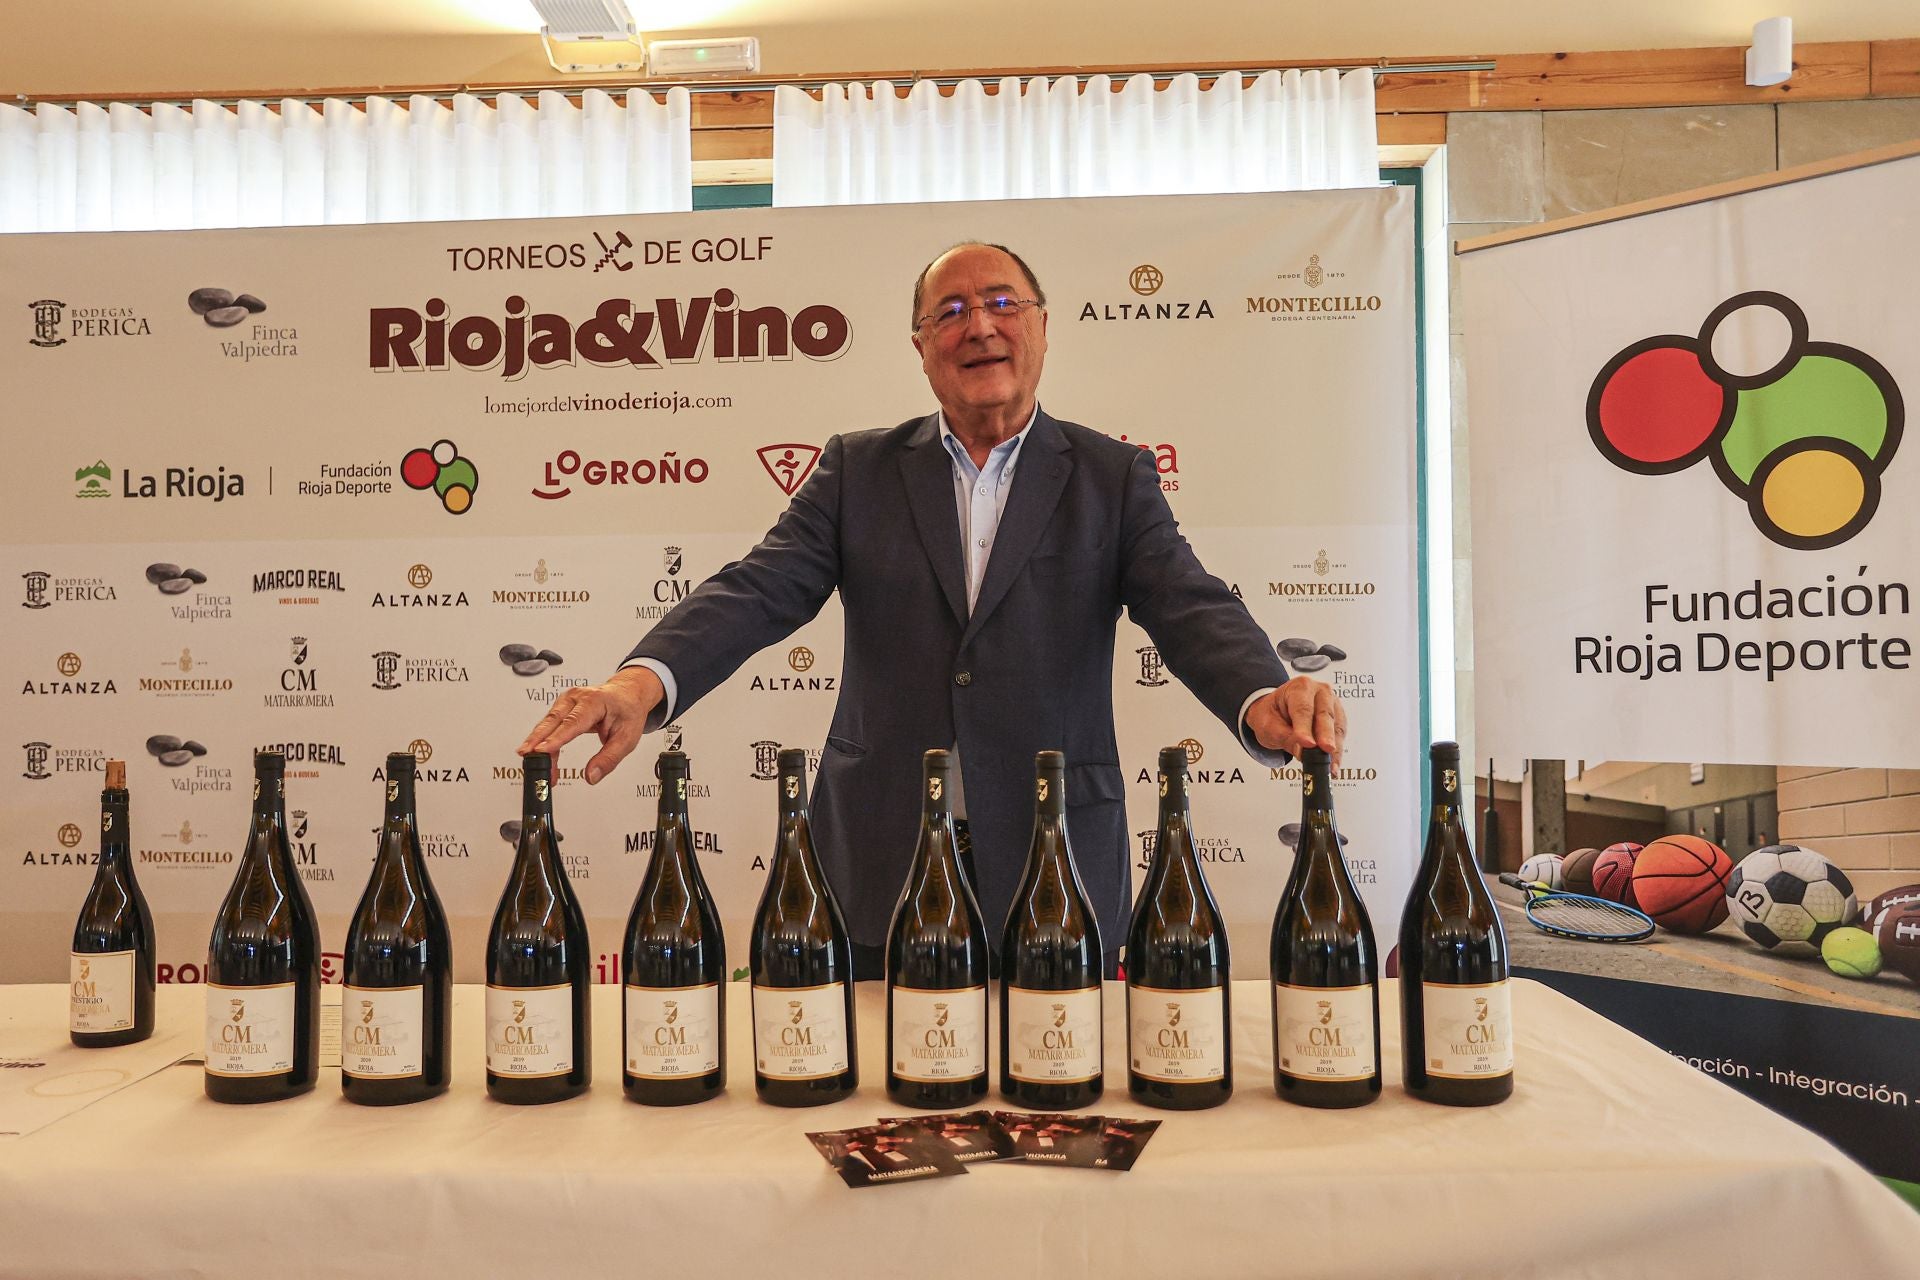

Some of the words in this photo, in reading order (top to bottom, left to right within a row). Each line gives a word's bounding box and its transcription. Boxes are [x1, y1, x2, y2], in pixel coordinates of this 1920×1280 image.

[447, 243, 586, 272] TORNEOS
[644, 241, 681, 264] DE
[691, 236, 774, 263] GOLF
[71, 308, 134, 317] BODEGAS
[1079, 299, 1215, 321] ALTANZA
[1246, 295, 1382, 313] MONTECILLO
[71, 318, 152, 338] PERICA
[252, 325, 298, 341] Finca
[370, 288, 852, 382] Rioja&Vino
[221, 341, 298, 362] Valpiedra
[484, 392, 732, 417] lomejordelvinoderioja.com
[321, 461, 391, 478] Fundación
[544, 449, 709, 485] LOGROÑO
[123, 469, 157, 498] La
[166, 467, 245, 502] Rioja
[299, 480, 331, 496] Rioja
[335, 479, 392, 496] Deporte
[55, 578, 104, 586] BODEGAS
[252, 569, 305, 594] MARCO
[308, 569, 346, 593] REAL
[1268, 582, 1376, 596] MONTECILLO
[54, 586, 117, 602] PERICA
[371, 592, 469, 607] ALTANZA
[492, 590, 590, 603] MONTECILLO
[653, 579, 691, 603] CM
[1645, 565, 1911, 623] Fundación
[196, 593, 232, 607] Finca
[171, 606, 232, 623] Valpiedra
[406, 659, 455, 667] BODEGAS
[1574, 634, 1682, 681] Rioja
[1697, 632, 1911, 682] Deporte
[281, 669, 317, 692] CM
[405, 667, 469, 683] PERICA
[552, 675, 589, 689] Finca
[751, 676, 835, 691] ALTANZ
[1333, 671, 1375, 685] Finca
[22, 680, 117, 695] ALTANZA
[139, 677, 233, 691] MONTECILLO
[1332, 684, 1375, 699] iedra
[264, 694, 335, 708] MATARROMERA
[525, 689, 559, 704] Valpi
[55, 749, 104, 757] BODEGAS
[308, 742, 346, 767] REAL
[55, 757, 108, 773] PERIC
[196, 765, 232, 779] Finca
[372, 765, 469, 782] AANZA
[492, 766, 588, 780] MONILLO
[1137, 768, 1245, 783] AANZA
[1270, 768, 1377, 781] MONILLO
[171, 778, 232, 795] Valpiedra
[427, 842, 470, 858] RICA
[625, 832, 656, 853] MAR
[694, 831, 723, 854] EAL
[22, 851, 100, 866] ALTANZ
[139, 849, 233, 864] MONTECILLO
[560, 853, 589, 866] inca
[1199, 847, 1246, 863] RICA
[1346, 857, 1376, 870] inca
[74, 981, 97, 998] CM
[222, 1024, 252, 1044] CM
[354, 1025, 381, 1046] CM
[505, 1025, 534, 1045] CM
[654, 1026, 686, 1046] CM
[781, 1026, 812, 1046] CM
[924, 1029, 956, 1048] CM
[1042, 1030, 1075, 1049] CM
[1157, 1028, 1189, 1048] CM
[1308, 1027, 1342, 1047] CM
[1466, 1025, 1496, 1044] CM
[1769, 1066, 1908, 1106] Integración
